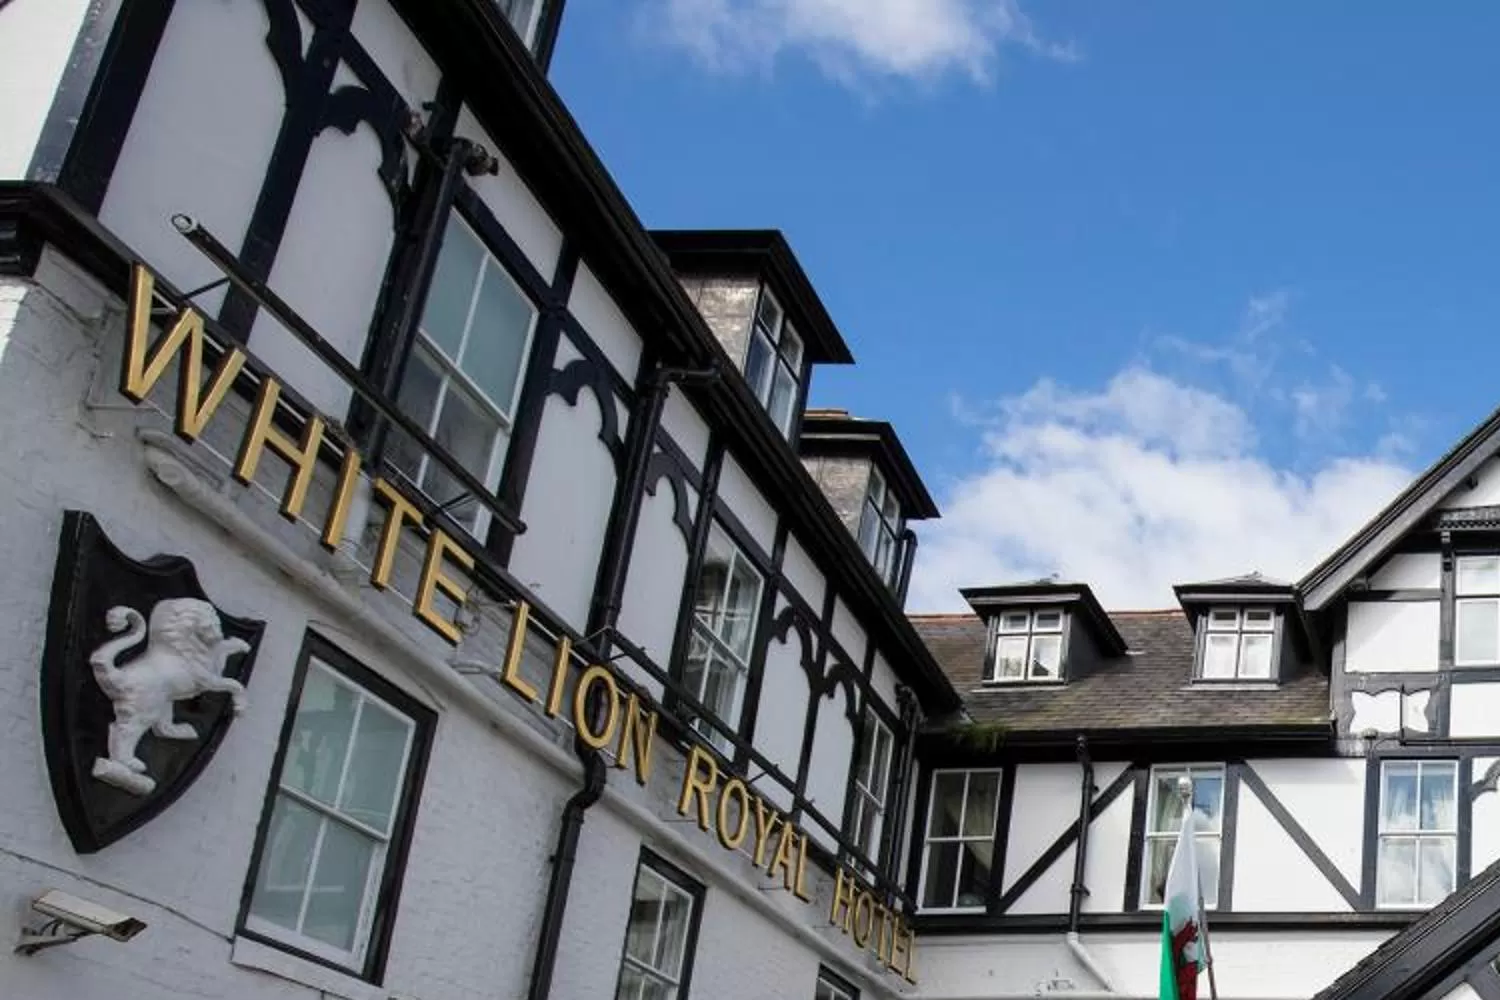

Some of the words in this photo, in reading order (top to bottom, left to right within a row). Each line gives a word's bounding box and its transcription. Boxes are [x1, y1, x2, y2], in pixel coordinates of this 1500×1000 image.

[119, 260, 475, 645] WHITE
[502, 601, 658, 786] LION
[677, 744, 812, 904] ROYAL
[829, 865, 916, 985] HOTEL
